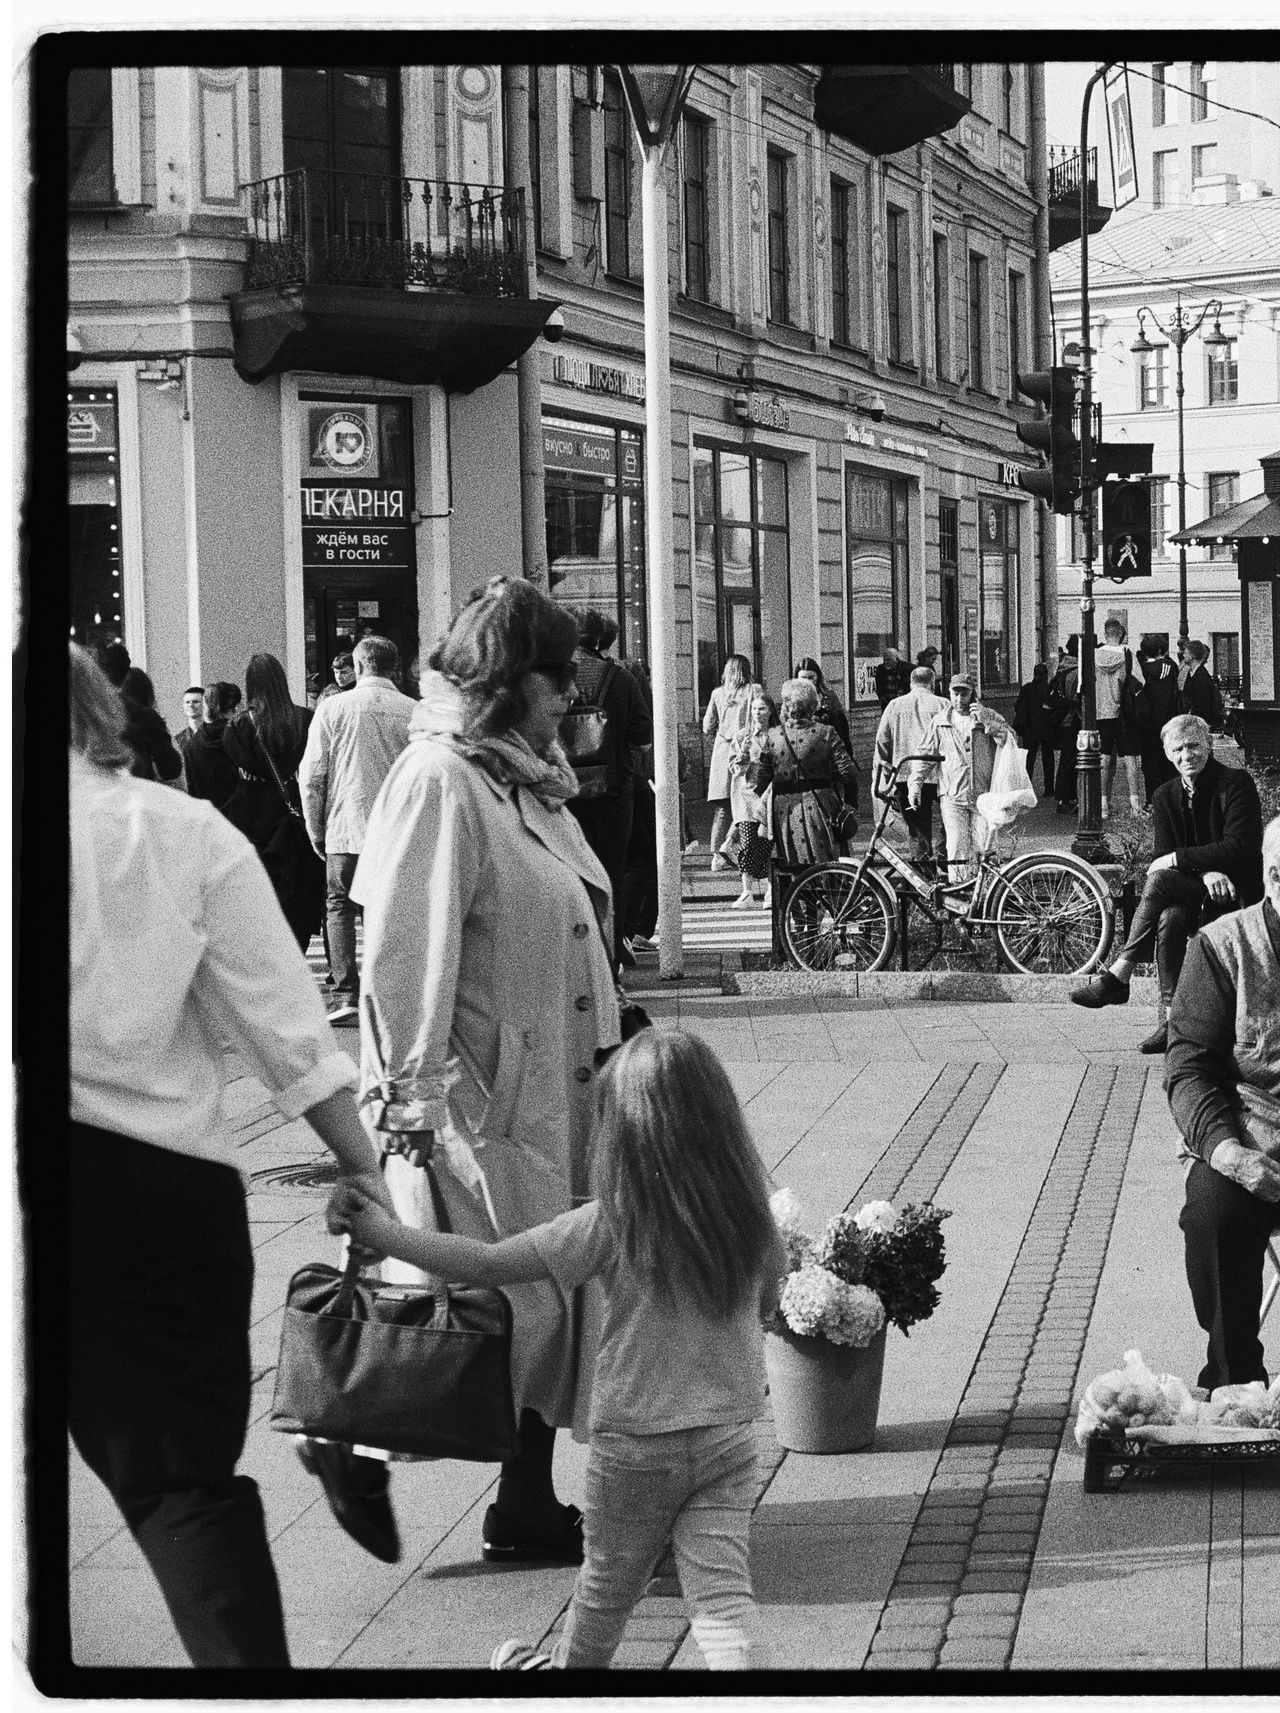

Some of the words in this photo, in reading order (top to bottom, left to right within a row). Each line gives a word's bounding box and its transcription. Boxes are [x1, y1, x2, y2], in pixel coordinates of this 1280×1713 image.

[563, 356, 590, 389] ЛЮДИ
[625, 370, 646, 399] ХЛЕБ
[545, 438, 573, 457] вкусно
[582, 441, 610, 462] быстро
[1003, 464, 1020, 486] KFC
[301, 488, 404, 518] ПЕКАРНЯ
[316, 531, 358, 547] ждём
[362, 534, 389, 546] вас
[326, 549, 335, 560] в
[339, 549, 381, 560] гости
